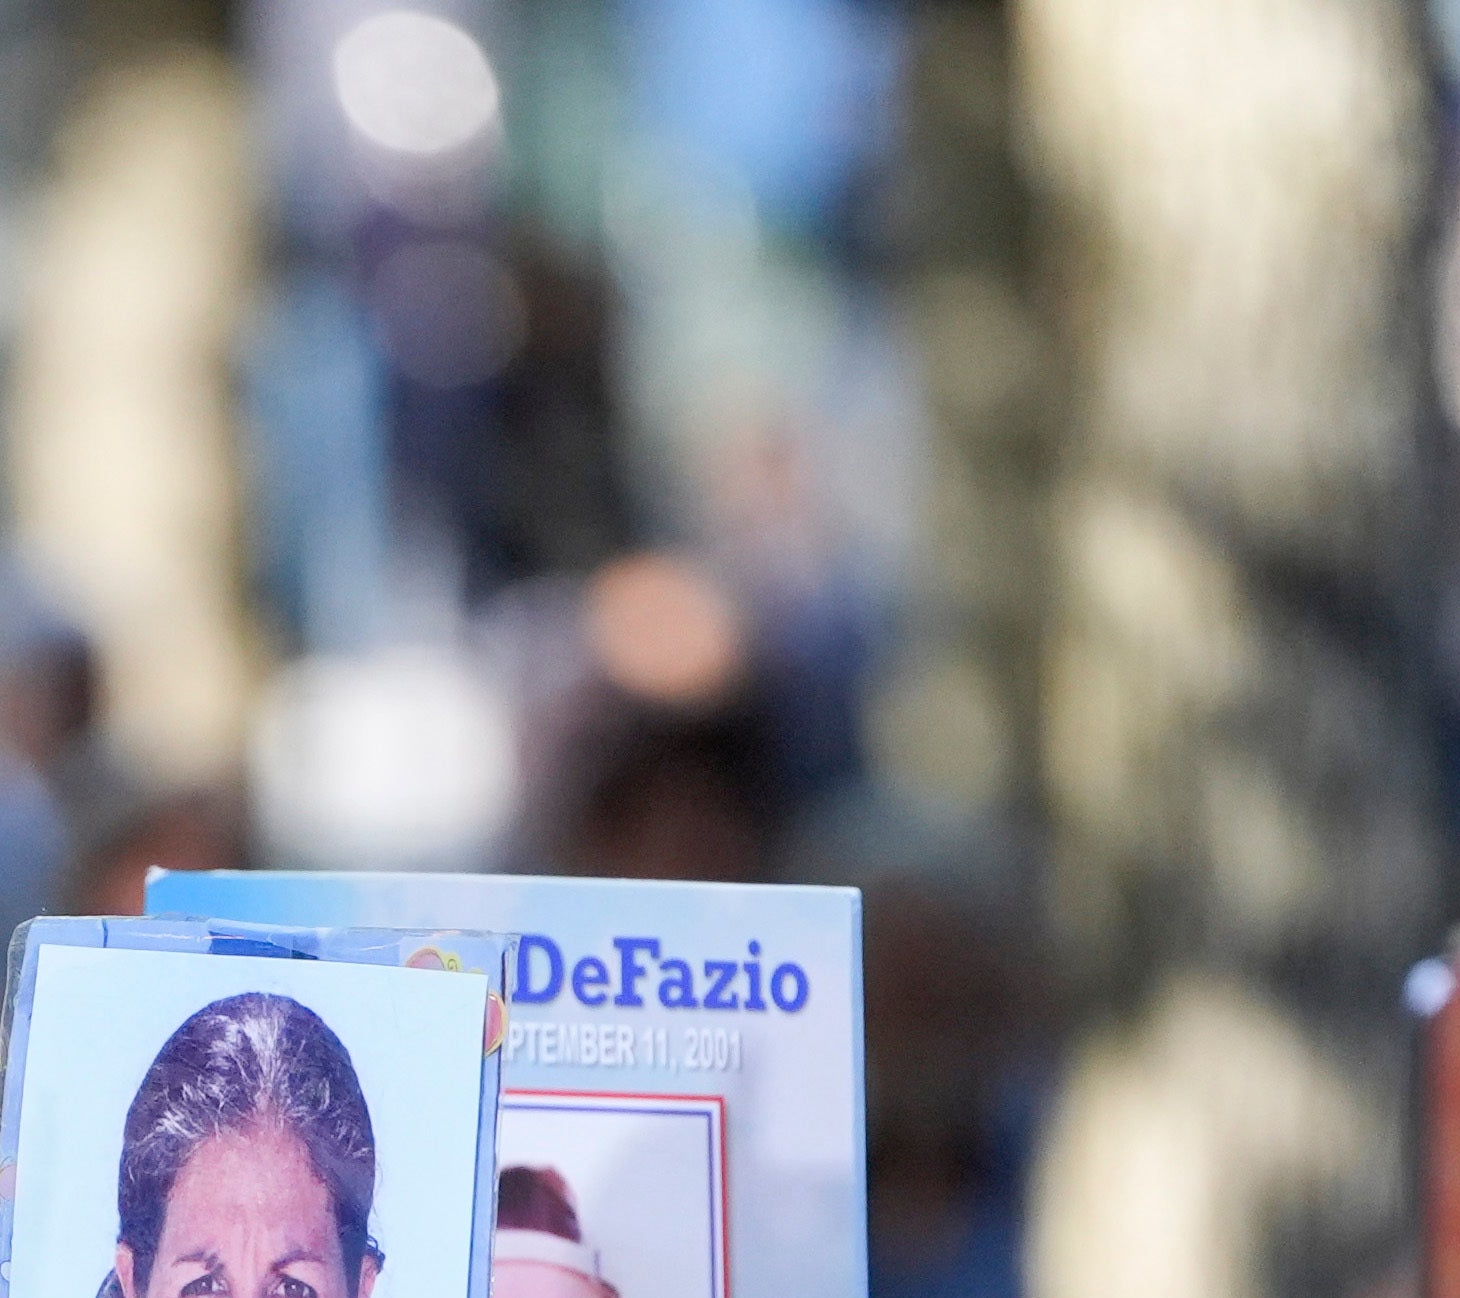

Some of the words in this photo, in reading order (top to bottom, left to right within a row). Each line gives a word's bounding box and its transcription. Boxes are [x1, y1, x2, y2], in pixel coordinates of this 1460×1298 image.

[510, 934, 810, 1013] DeFazio
[505, 1021, 635, 1067] PTEMBER
[640, 1025, 680, 1075] 11,
[684, 1026, 743, 1071] 2001
